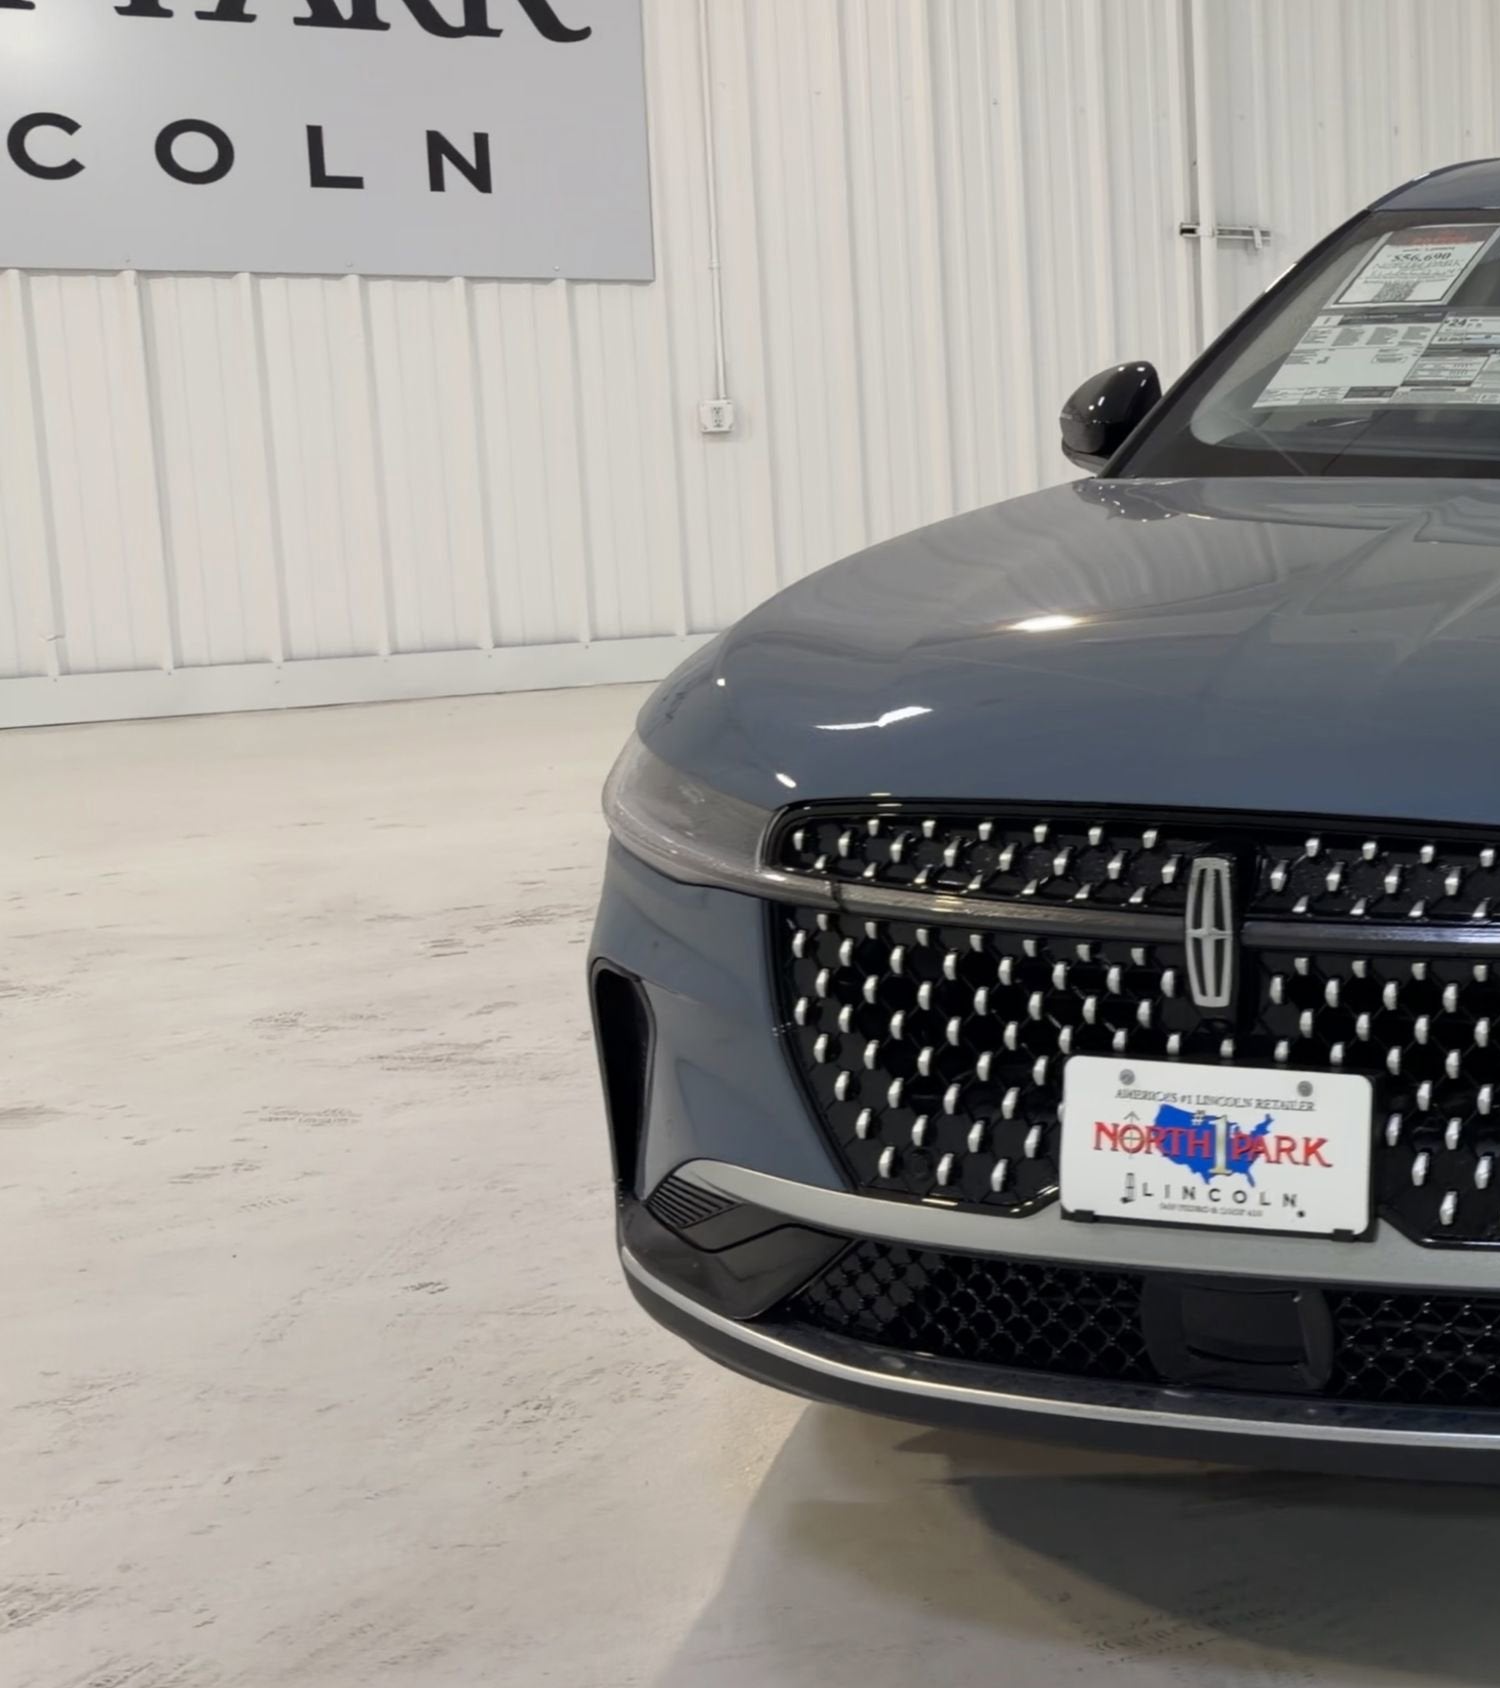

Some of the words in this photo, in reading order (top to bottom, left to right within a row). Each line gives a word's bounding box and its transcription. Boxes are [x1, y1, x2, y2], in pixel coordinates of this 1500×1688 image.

[1195, 1095, 1253, 1109] LINCOLN
[1255, 1098, 1316, 1112] RETAILER
[1093, 1121, 1213, 1159] NORTH
[1231, 1131, 1334, 1169] PARK
[1141, 1181, 1299, 1208] LINCOLN
